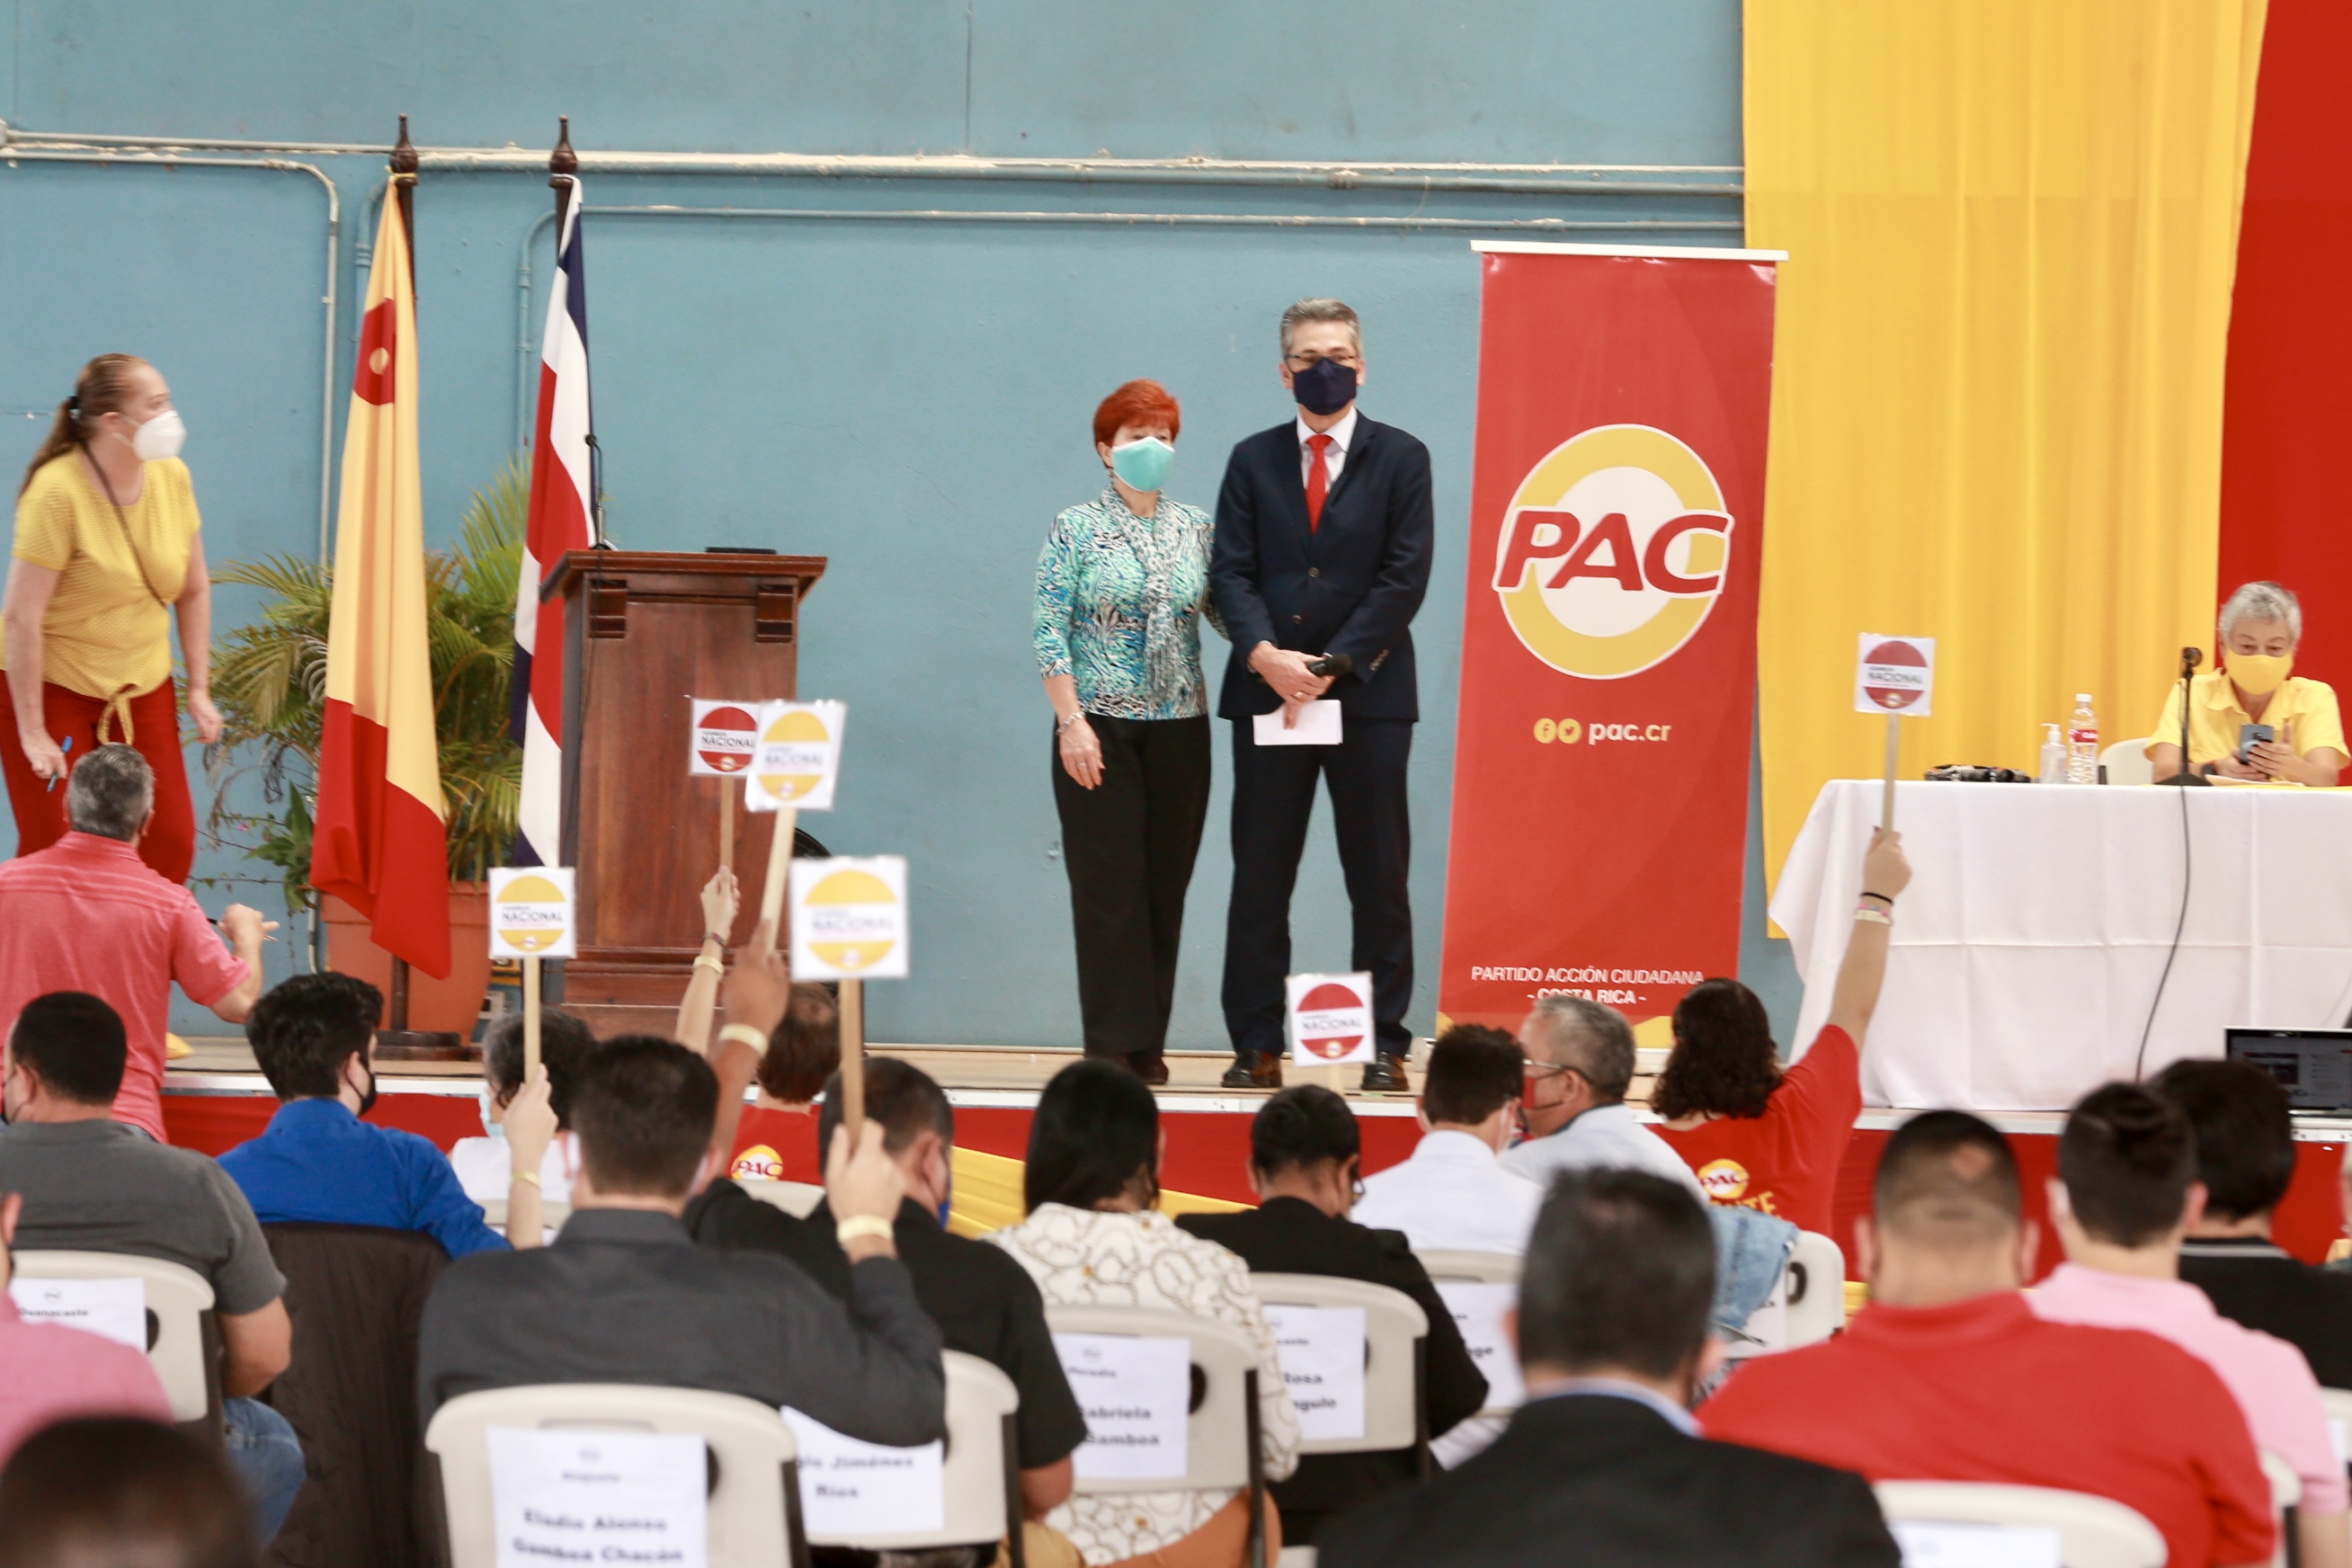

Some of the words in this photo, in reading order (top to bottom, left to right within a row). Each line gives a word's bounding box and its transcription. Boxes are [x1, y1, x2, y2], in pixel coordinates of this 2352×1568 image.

[1495, 507, 1733, 596] PAC
[701, 735, 755, 747] NACIONAL
[1588, 723, 1671, 746] pac.cr
[502, 911, 563, 922] NACIONAL
[1471, 966, 1544, 983] PARTIDO
[1545, 965, 1608, 984] ACCIÓN
[1610, 968, 1705, 985] CIUDADANA
[1596, 989, 1637, 1004] RICA
[732, 1160, 783, 1177] PAC
[1082, 1406, 1152, 1419] abriela
